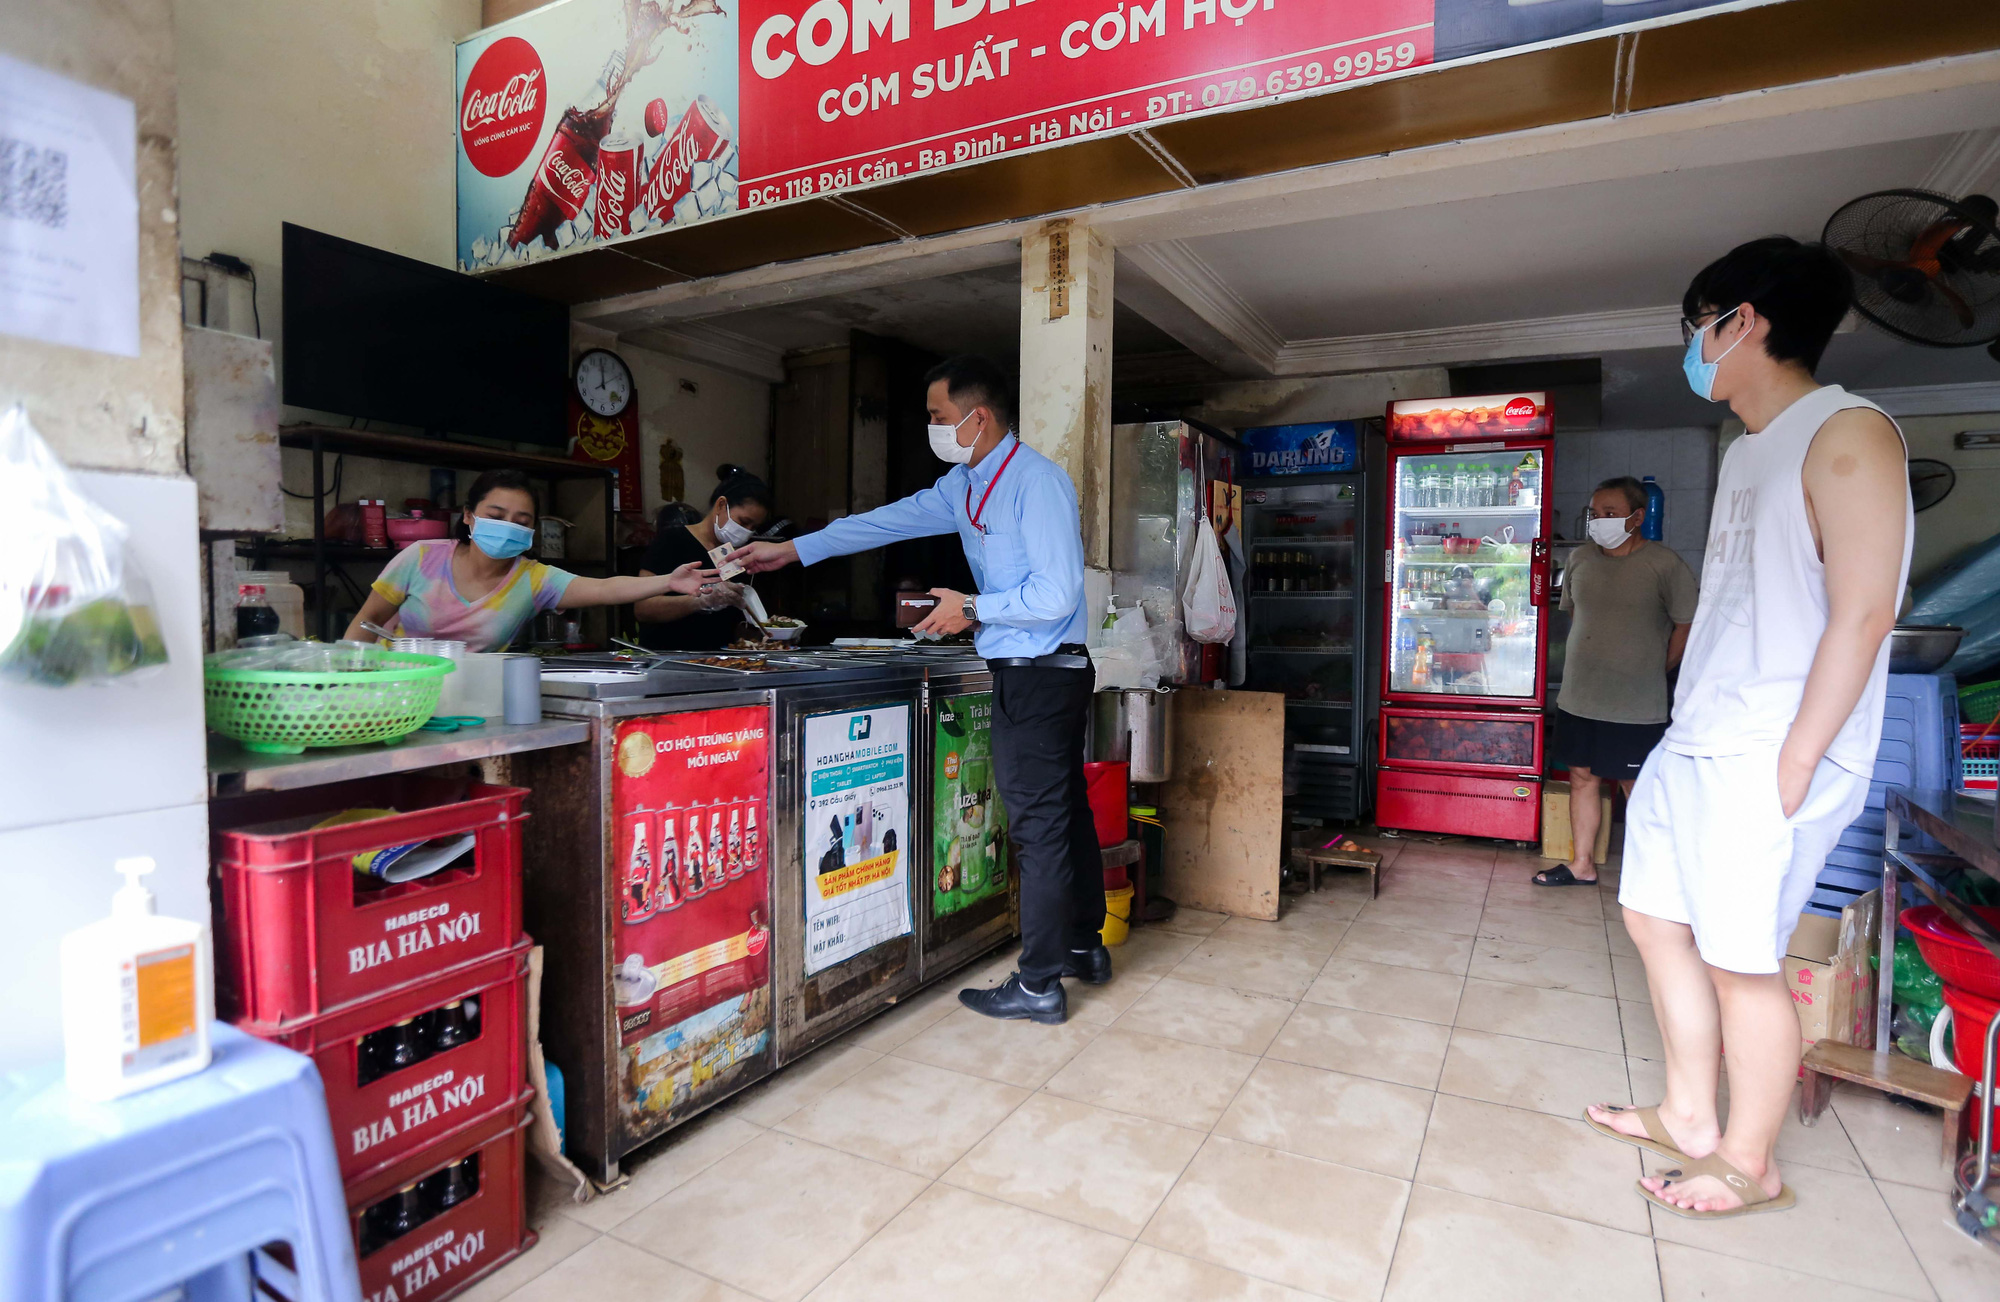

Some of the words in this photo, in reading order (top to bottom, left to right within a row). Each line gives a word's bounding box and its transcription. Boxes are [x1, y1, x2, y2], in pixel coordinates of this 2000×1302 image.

[817, 71, 900, 123] CƠM
[911, 34, 1019, 99] SUẤT
[1060, 0, 1166, 59] CƠM
[748, 186, 781, 208] ĐC:
[785, 176, 813, 196] 118
[858, 158, 898, 183] Cấn
[919, 150, 947, 170] Ba
[953, 132, 1006, 162] Đình
[1029, 119, 1061, 144] Hà
[1069, 107, 1113, 135] Nội
[1146, 90, 1192, 119] ĐT:
[1201, 42, 1416, 107] 079.639.9959
[1505, 405, 1534, 416] Coca-Cola
[1252, 447, 1344, 468] DARLING
[970, 704, 982, 718] Trà
[655, 739, 674, 753] CƠ
[675, 735, 695, 752] HỘI
[697, 730, 733, 748] TRÚNG
[734, 728, 764, 743] VÀNG
[687, 752, 709, 769] MỖI
[710, 750, 740, 765] NGÀY
[817, 743, 898, 766] HOANGHAMOBILE.COM
[855, 863, 875, 875] CHÍNH
[836, 881, 847, 893] TỐT
[385, 903, 450, 931] HABECO
[813, 919, 824, 932] TÊN
[826, 914, 840, 928] WIFI:
[348, 940, 393, 974] BIA
[398, 923, 434, 959] HÀ
[438, 912, 481, 945] NỘI
[1799, 974, 1811, 982] UP
[389, 1070, 455, 1108] HABECO
[352, 1116, 398, 1155] BIA
[402, 1093, 439, 1133] HÀ
[442, 1075, 485, 1113] NỘI
[391, 1229, 455, 1276] HABECO
[404, 1256, 441, 1297] HÀ
[443, 1229, 486, 1273] NỘI
